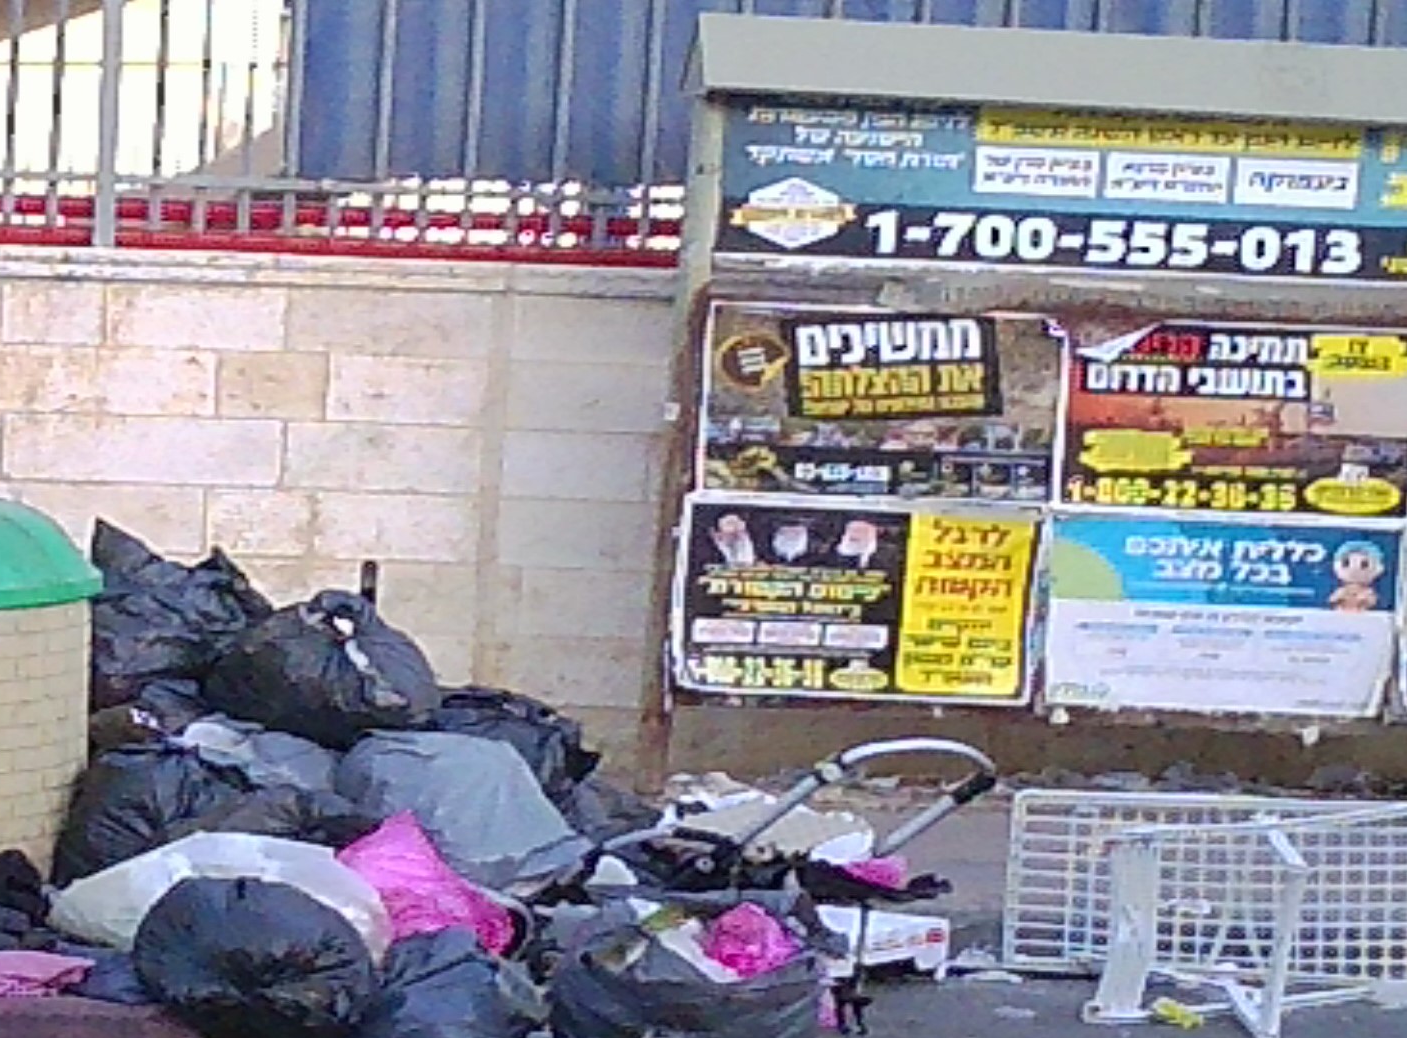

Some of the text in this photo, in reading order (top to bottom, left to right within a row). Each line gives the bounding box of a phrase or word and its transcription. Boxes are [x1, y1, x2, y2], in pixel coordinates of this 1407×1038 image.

[864, 209, 1363, 275] 1-700-555-013
[794, 318, 982, 367] ממשיכים
[1208, 332, 1308, 364] תמיכה
[937, 363, 984, 393] את
[1086, 362, 1307, 398] בתושבי הדרום
[1125, 534, 1327, 564] כללית איתכם
[1151, 557, 1292, 586] בכל מצב
